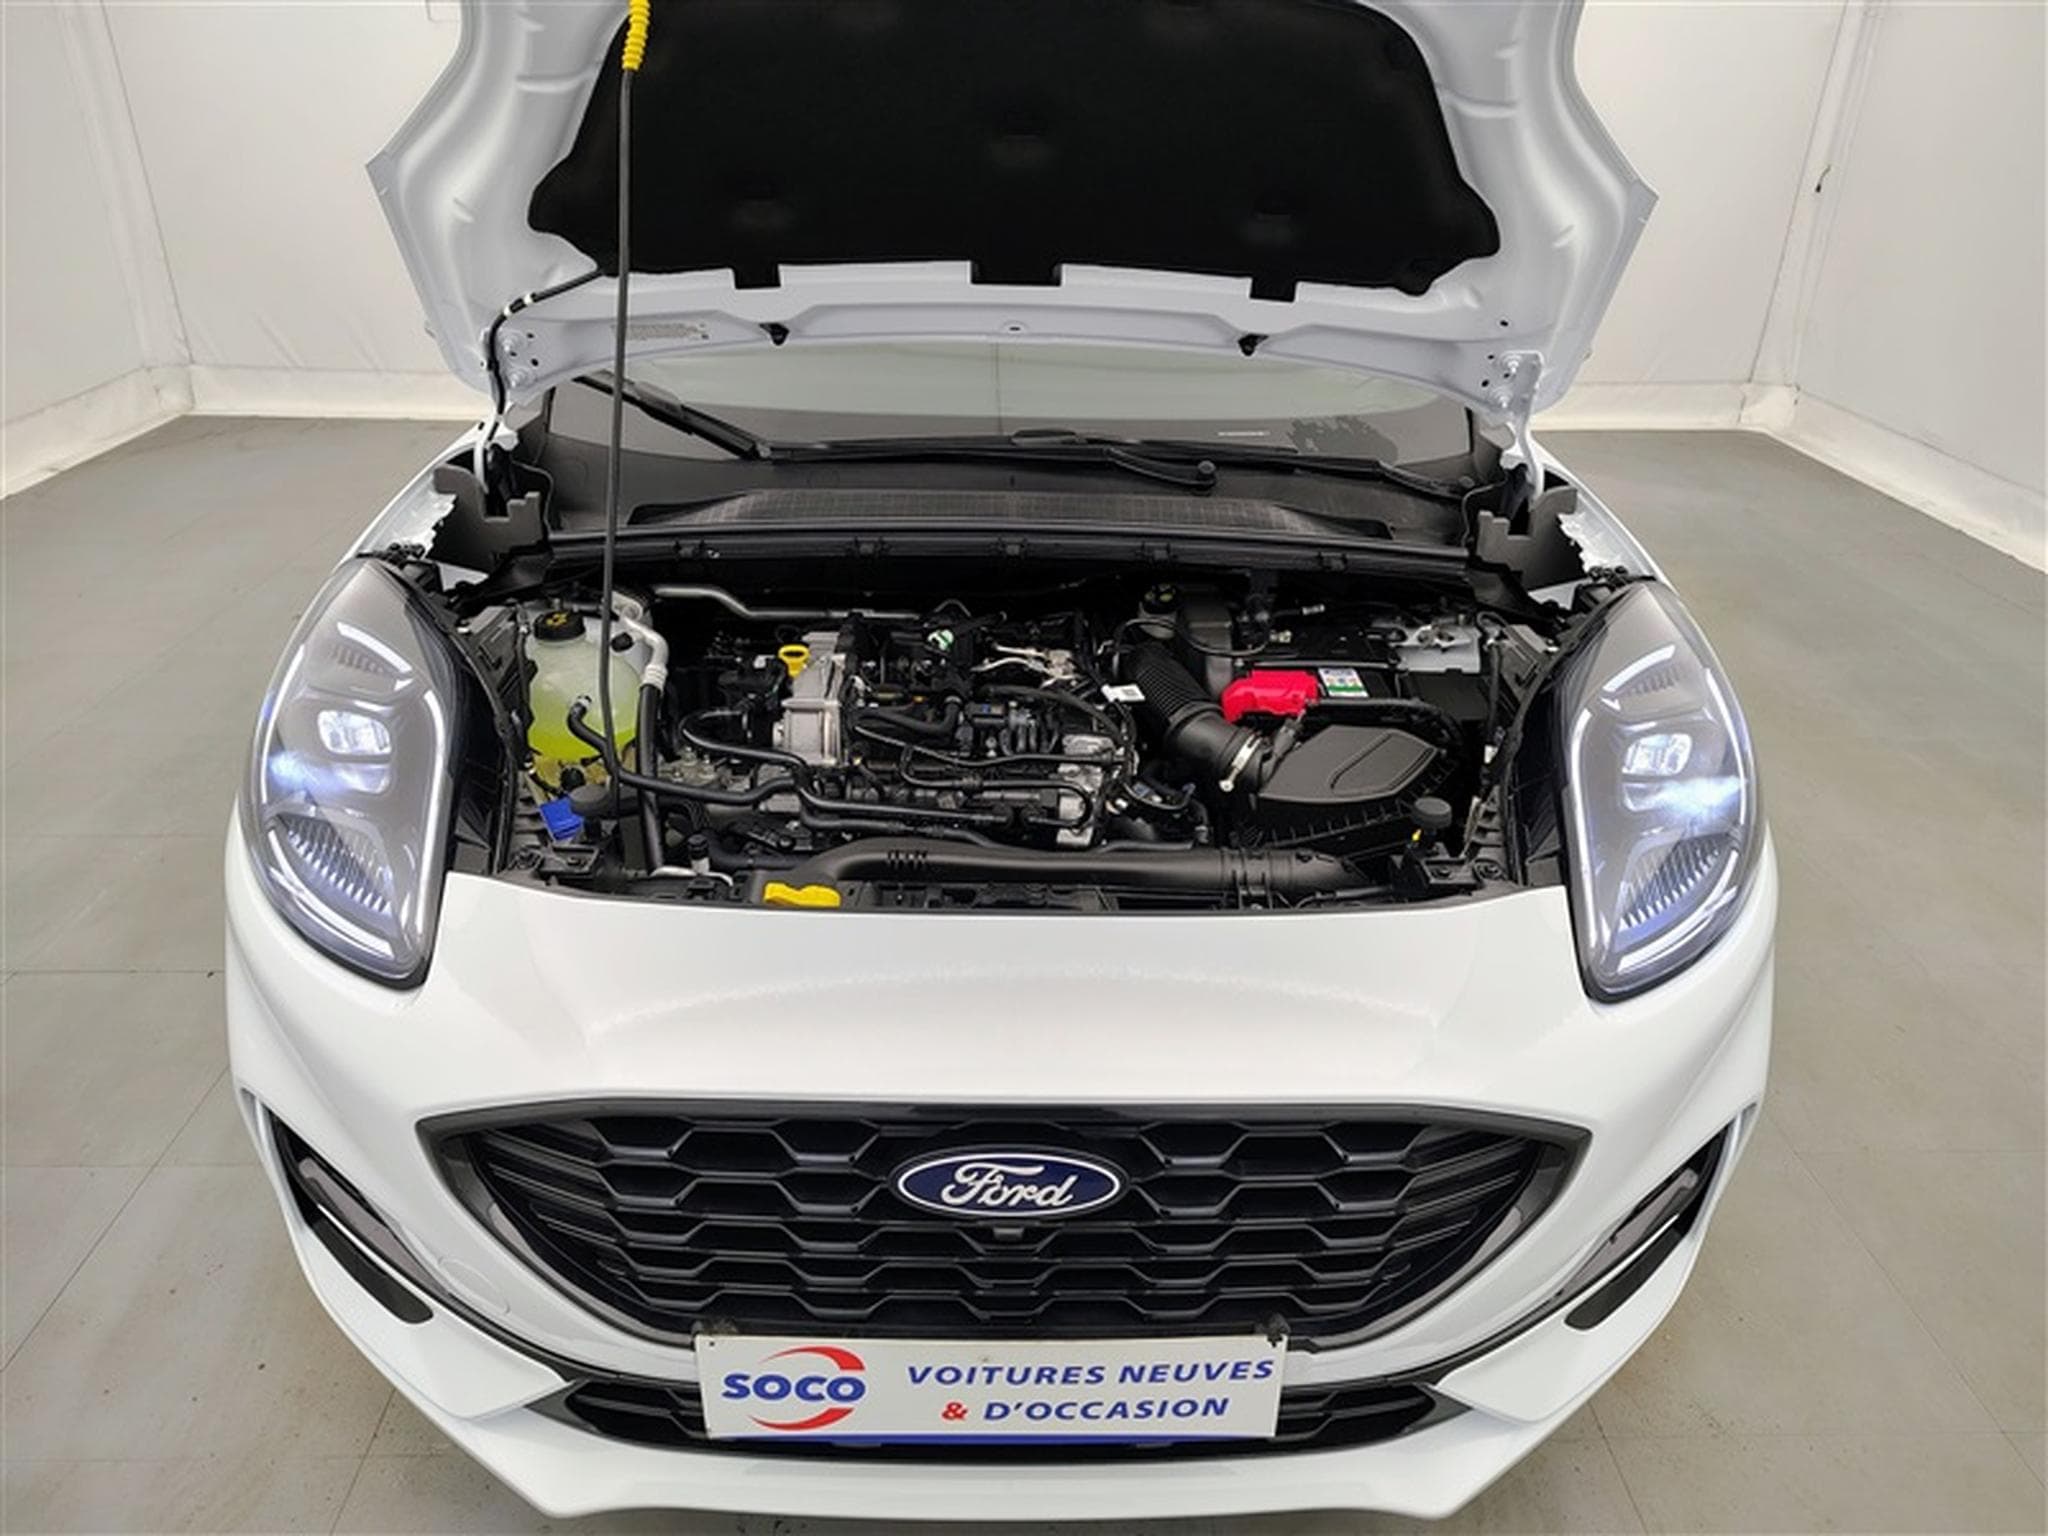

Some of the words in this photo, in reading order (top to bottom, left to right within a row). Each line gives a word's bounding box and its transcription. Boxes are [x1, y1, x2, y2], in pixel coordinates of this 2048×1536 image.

[941, 1162, 1078, 1206] Ford
[907, 1365, 1106, 1385] VOITURES
[1118, 1360, 1274, 1384] NEUVES
[722, 1373, 866, 1403] SOCO
[941, 1402, 968, 1421] &
[983, 1397, 1230, 1421] D'OCCASION
